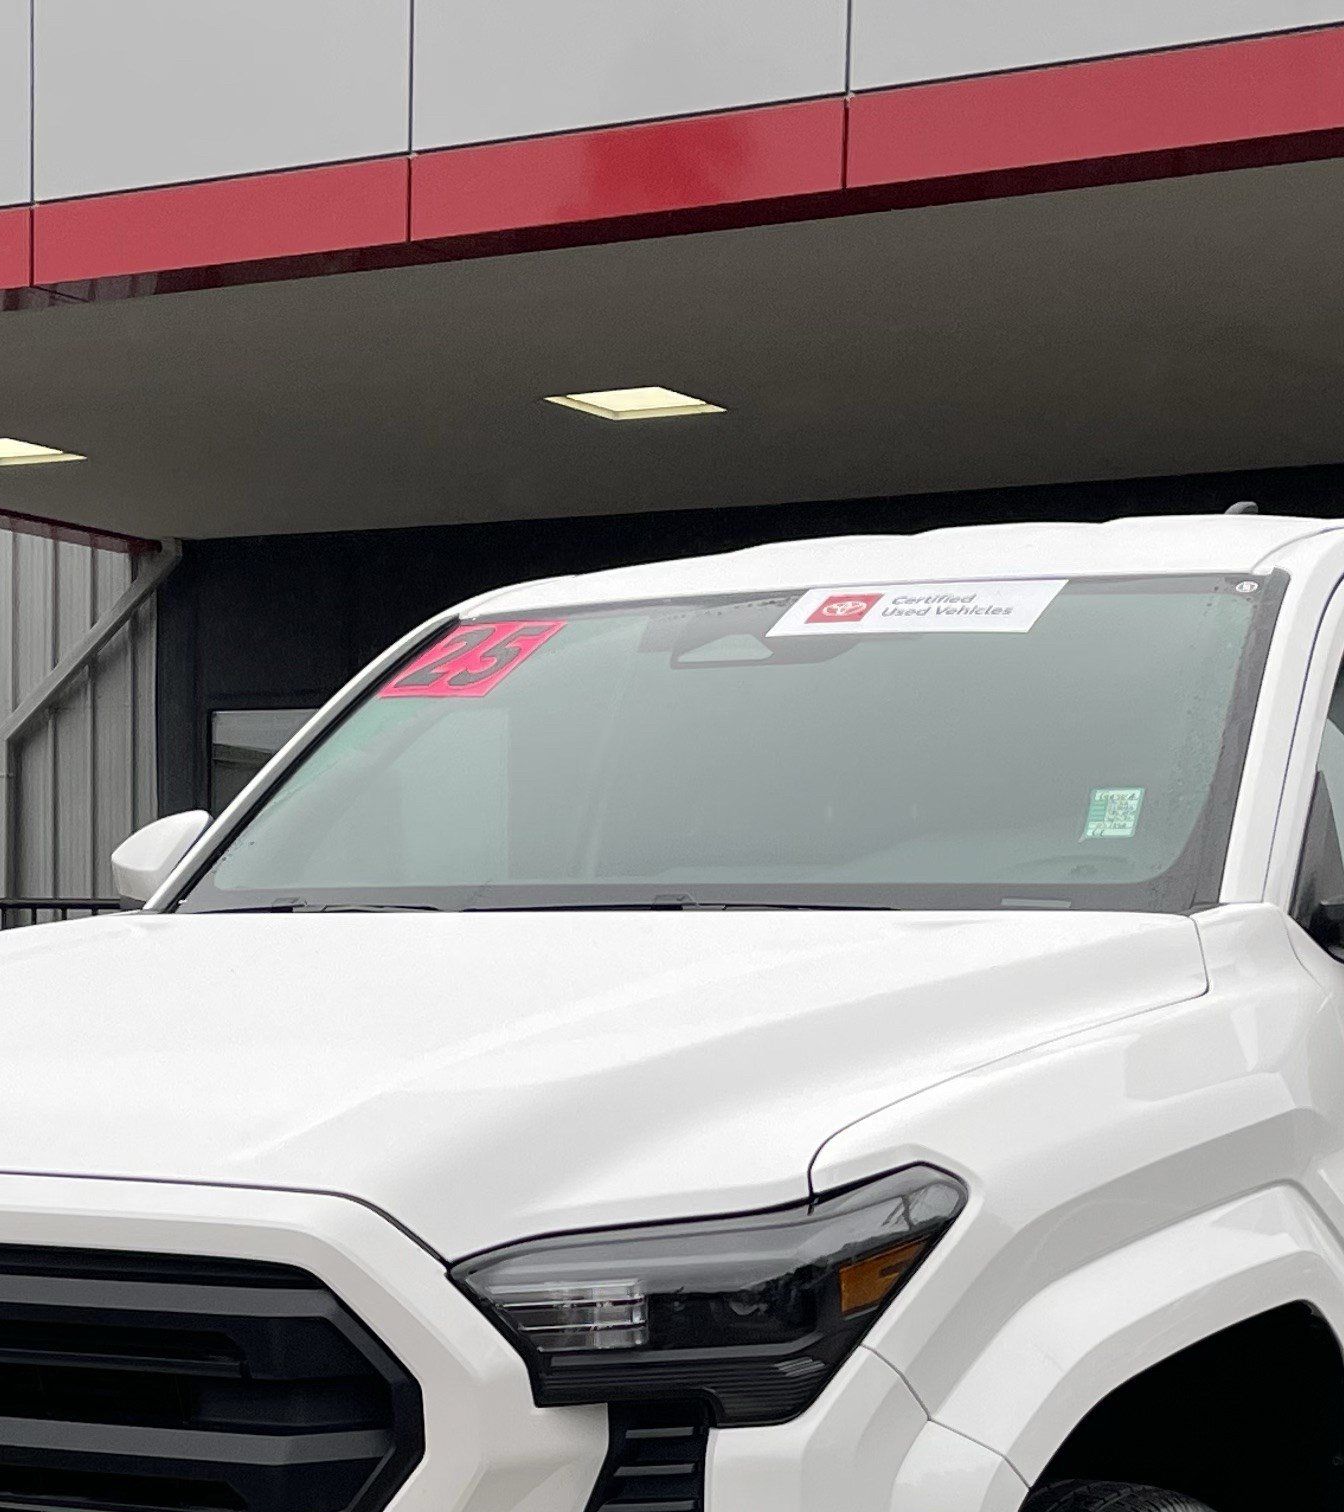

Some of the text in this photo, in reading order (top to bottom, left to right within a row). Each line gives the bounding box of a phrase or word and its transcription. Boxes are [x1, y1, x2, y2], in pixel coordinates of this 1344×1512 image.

[892, 592, 976, 606] Certified
[881, 604, 1014, 618] Used Vehicles
[393, 625, 553, 688] 25
